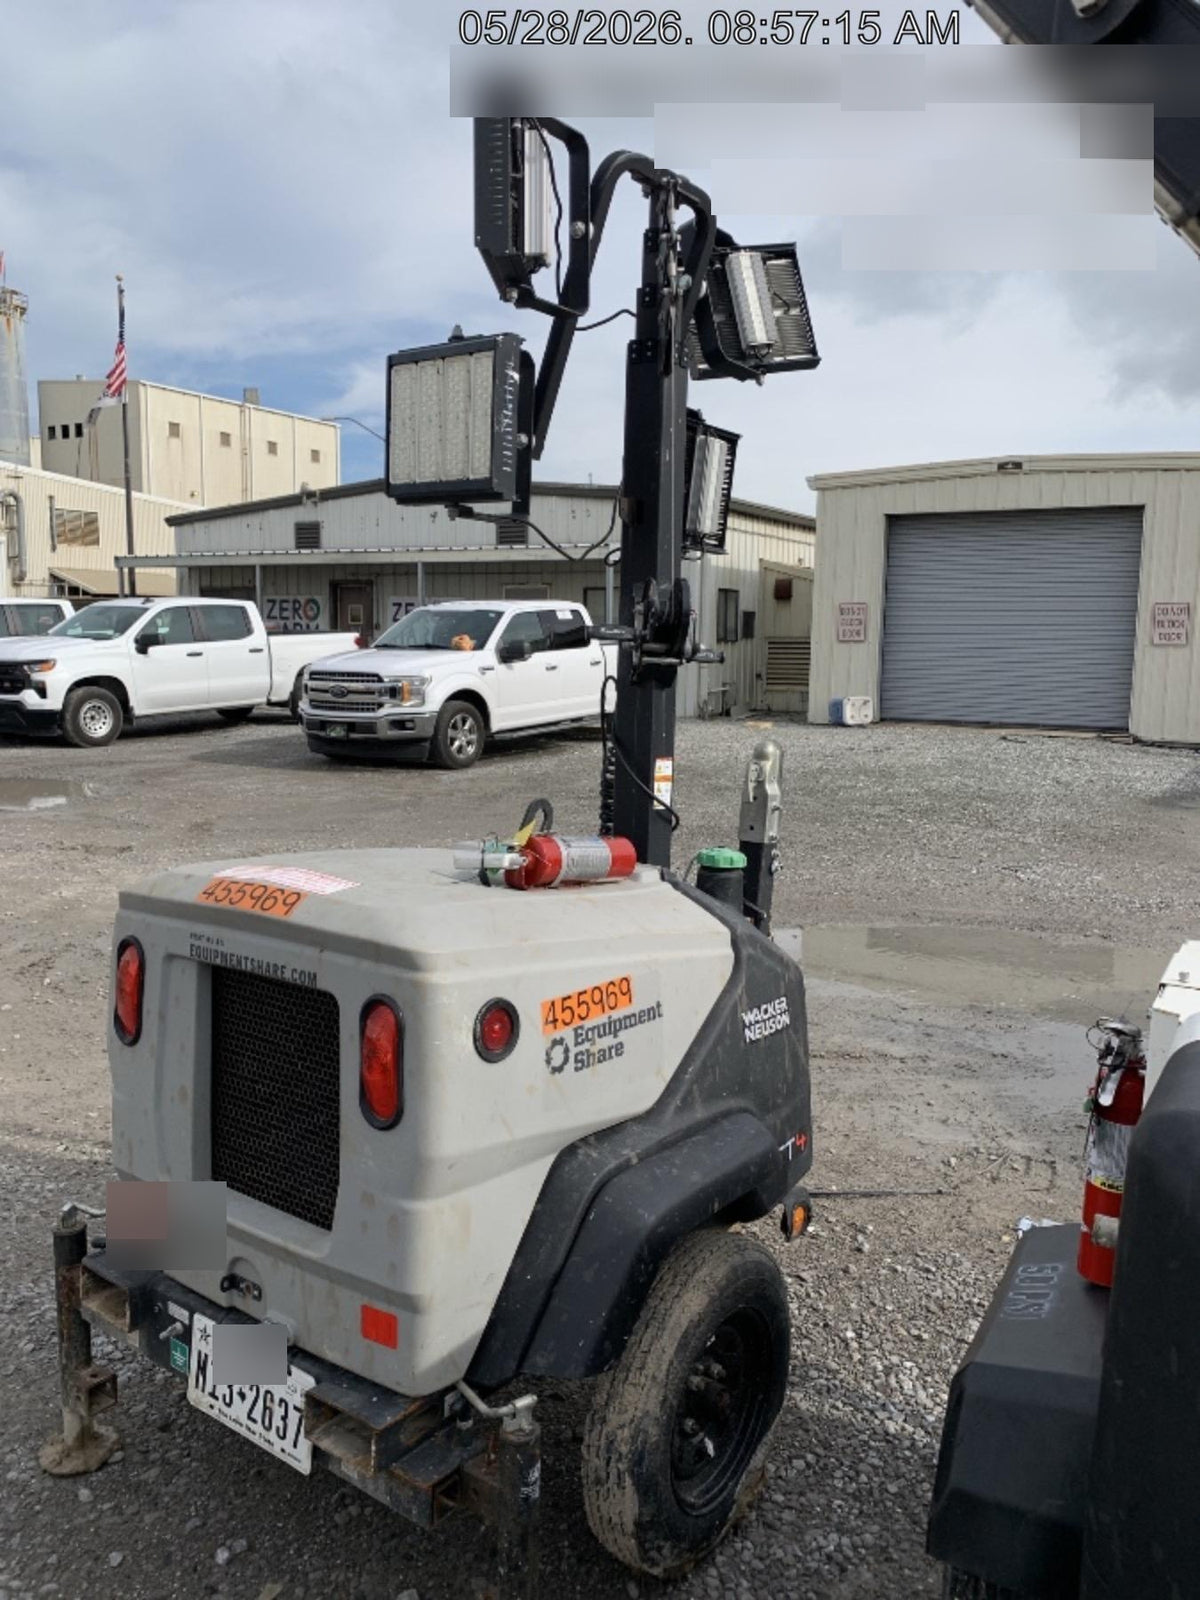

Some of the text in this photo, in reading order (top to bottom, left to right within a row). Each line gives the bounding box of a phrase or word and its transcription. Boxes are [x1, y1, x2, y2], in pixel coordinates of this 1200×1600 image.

[202, 879, 302, 916] 455969
[190, 943, 318, 988] EQUIPMENTSHARE.COM
[545, 976, 632, 1031] 455969
[741, 996, 788, 1027] WACKER
[573, 1000, 663, 1048] Equipment
[744, 1011, 790, 1043] NEUSON
[574, 1041, 625, 1073] Share
